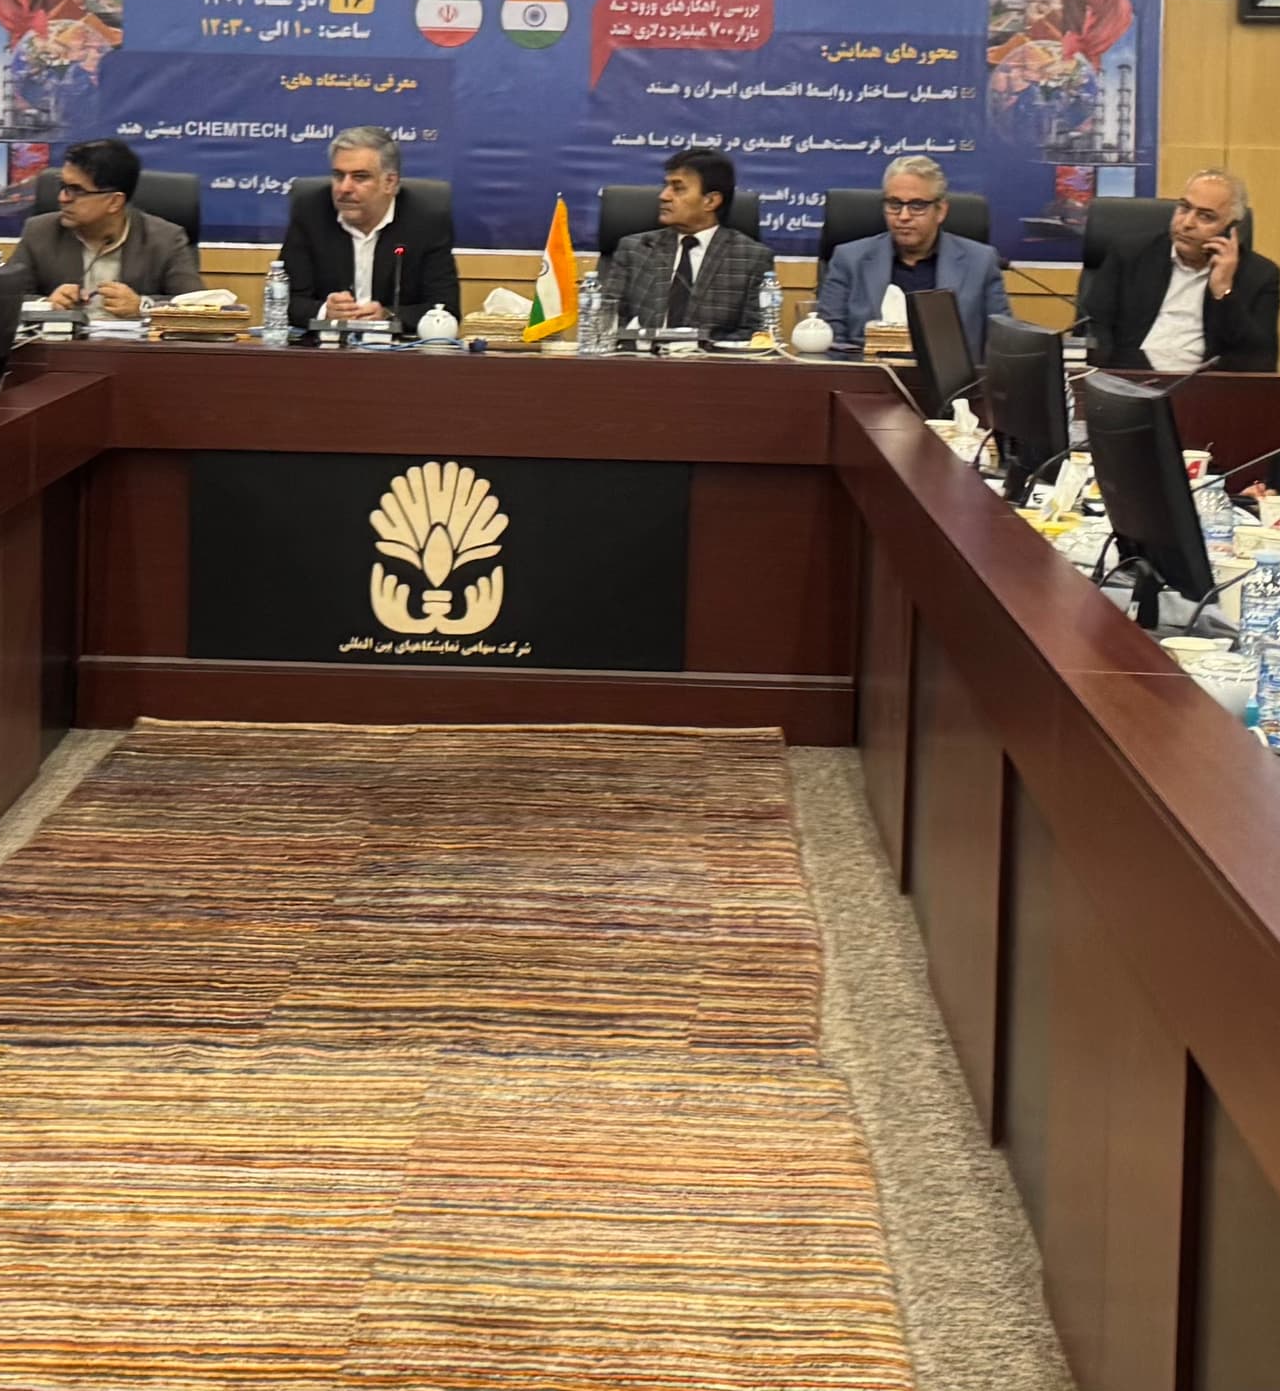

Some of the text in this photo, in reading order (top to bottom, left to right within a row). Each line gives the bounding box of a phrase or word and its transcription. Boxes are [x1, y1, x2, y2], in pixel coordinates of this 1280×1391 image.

[630, 0, 658, 16] ورود
[258, 19, 289, 42] الی
[317, 20, 372, 39] ساعت:
[821, 42, 959, 66] محورهای همایش:
[315, 73, 372, 91] نمایشگاه
[373, 73, 419, 93] معرفی
[645, 80, 958, 103] تحلیل ساختار روابط اقتصادی ایران و هند
[116, 121, 143, 135] هند
[185, 121, 288, 138] CHEMTECH
[290, 124, 334, 143] المللی
[612, 133, 647, 146] هند
[670, 132, 723, 150] تجارت
[725, 137, 741, 152] در
[742, 133, 794, 153] کلیدی
[883, 137, 957, 156] شناسایی
[786, 213, 825, 231] نایع
[339, 636, 373, 652] المللی
[374, 639, 393, 653] بین
[461, 640, 496, 656] سهامی
[497, 641, 532, 657] شرکت
